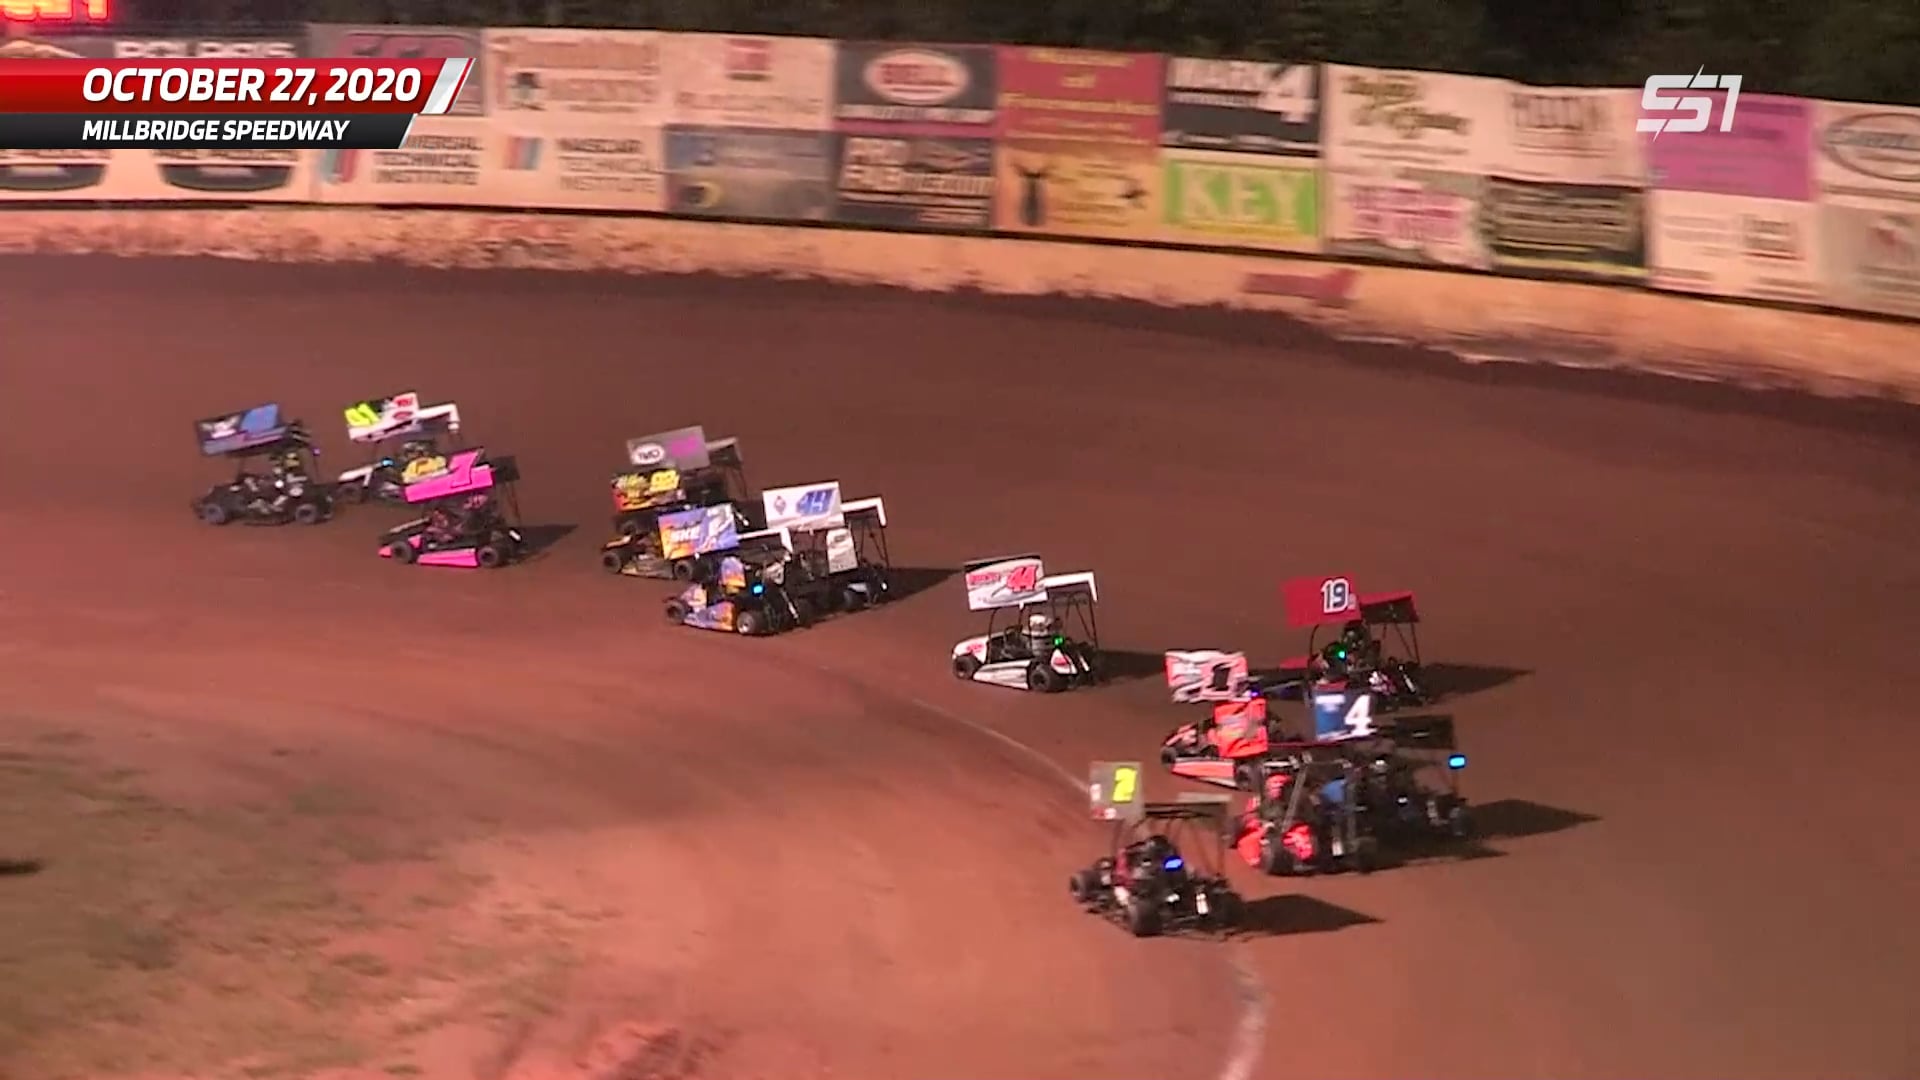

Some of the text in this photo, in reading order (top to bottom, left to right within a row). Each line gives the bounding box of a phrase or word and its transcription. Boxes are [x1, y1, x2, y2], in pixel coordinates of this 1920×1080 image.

[1180, 163, 1308, 232] KEY
[1007, 564, 1039, 593] 44
[1344, 694, 1373, 735] 4
[1112, 767, 1138, 802] 2
